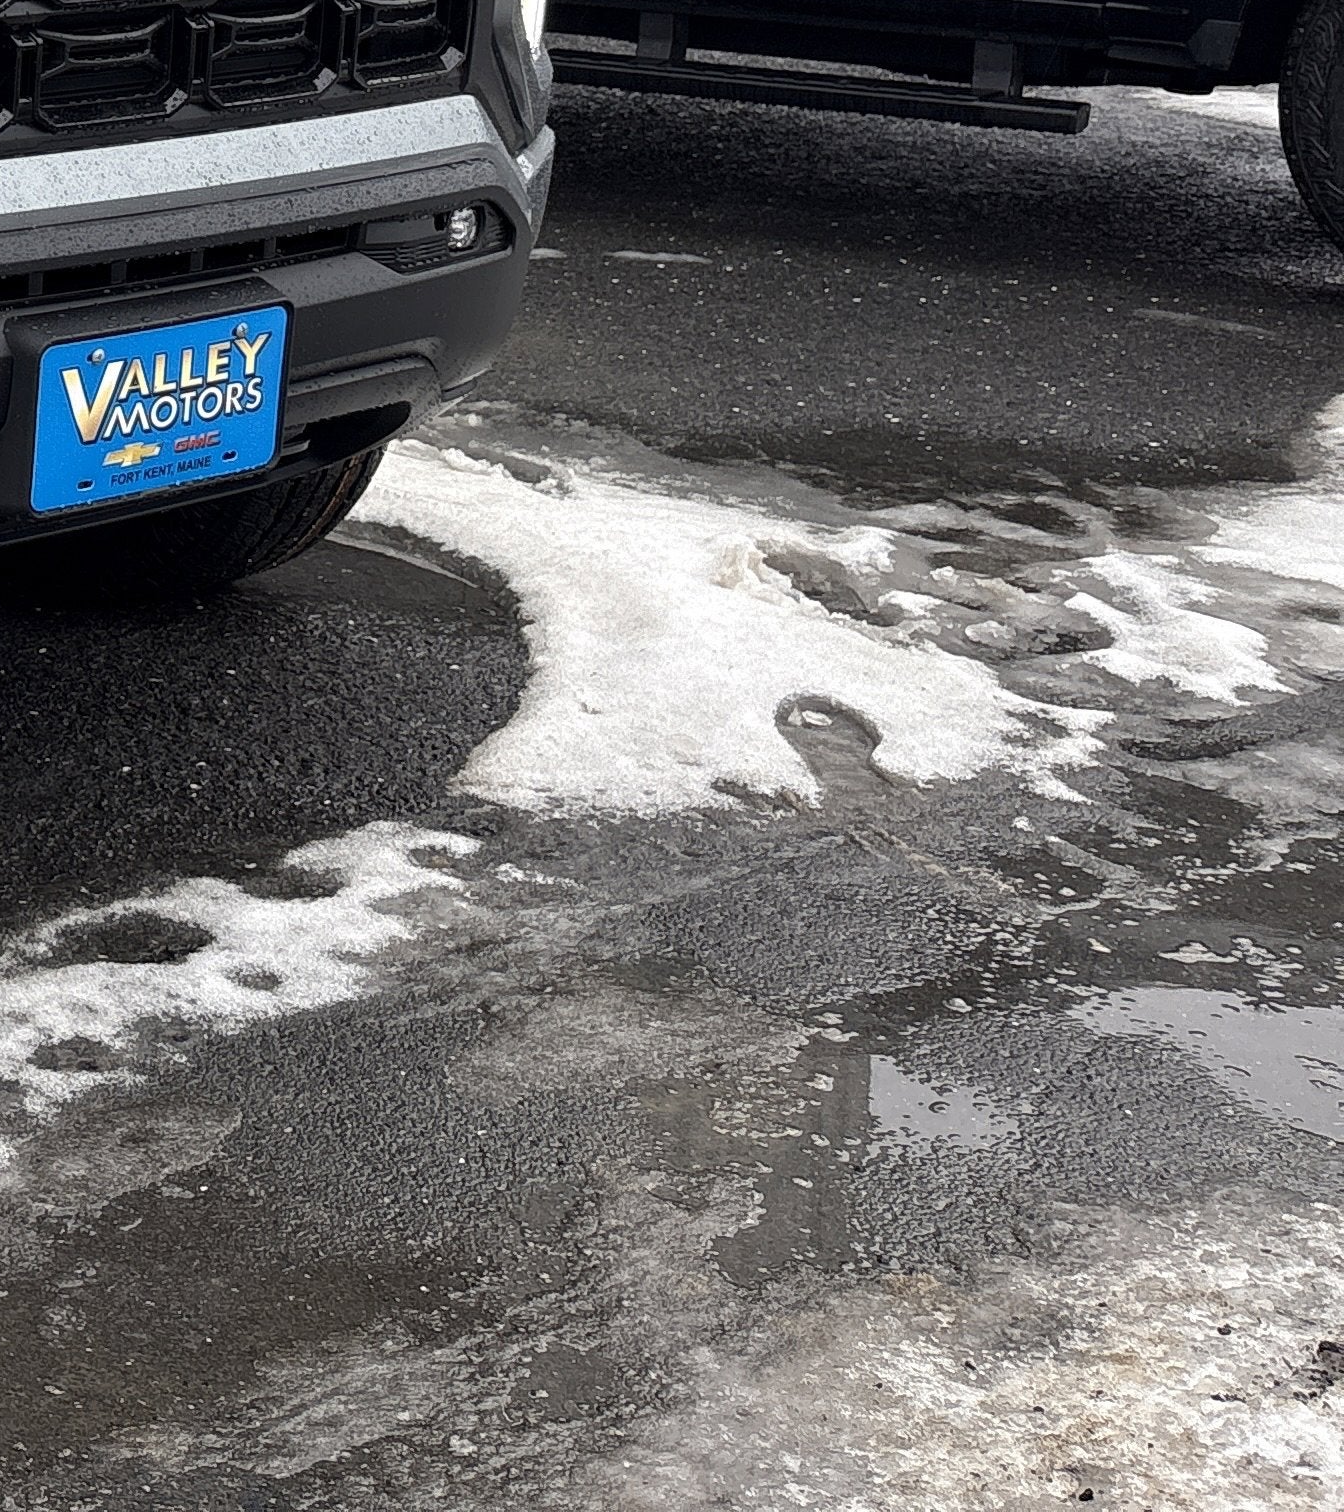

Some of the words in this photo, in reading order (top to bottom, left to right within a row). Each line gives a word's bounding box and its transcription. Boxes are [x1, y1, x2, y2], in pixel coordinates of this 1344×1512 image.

[60, 332, 272, 444] VALLEY
[102, 376, 264, 440] MOTORS
[172, 430, 222, 455] GMC
[110, 470, 141, 487] FORT
[142, 463, 176, 480] KENT,
[176, 456, 213, 473] MAINE
